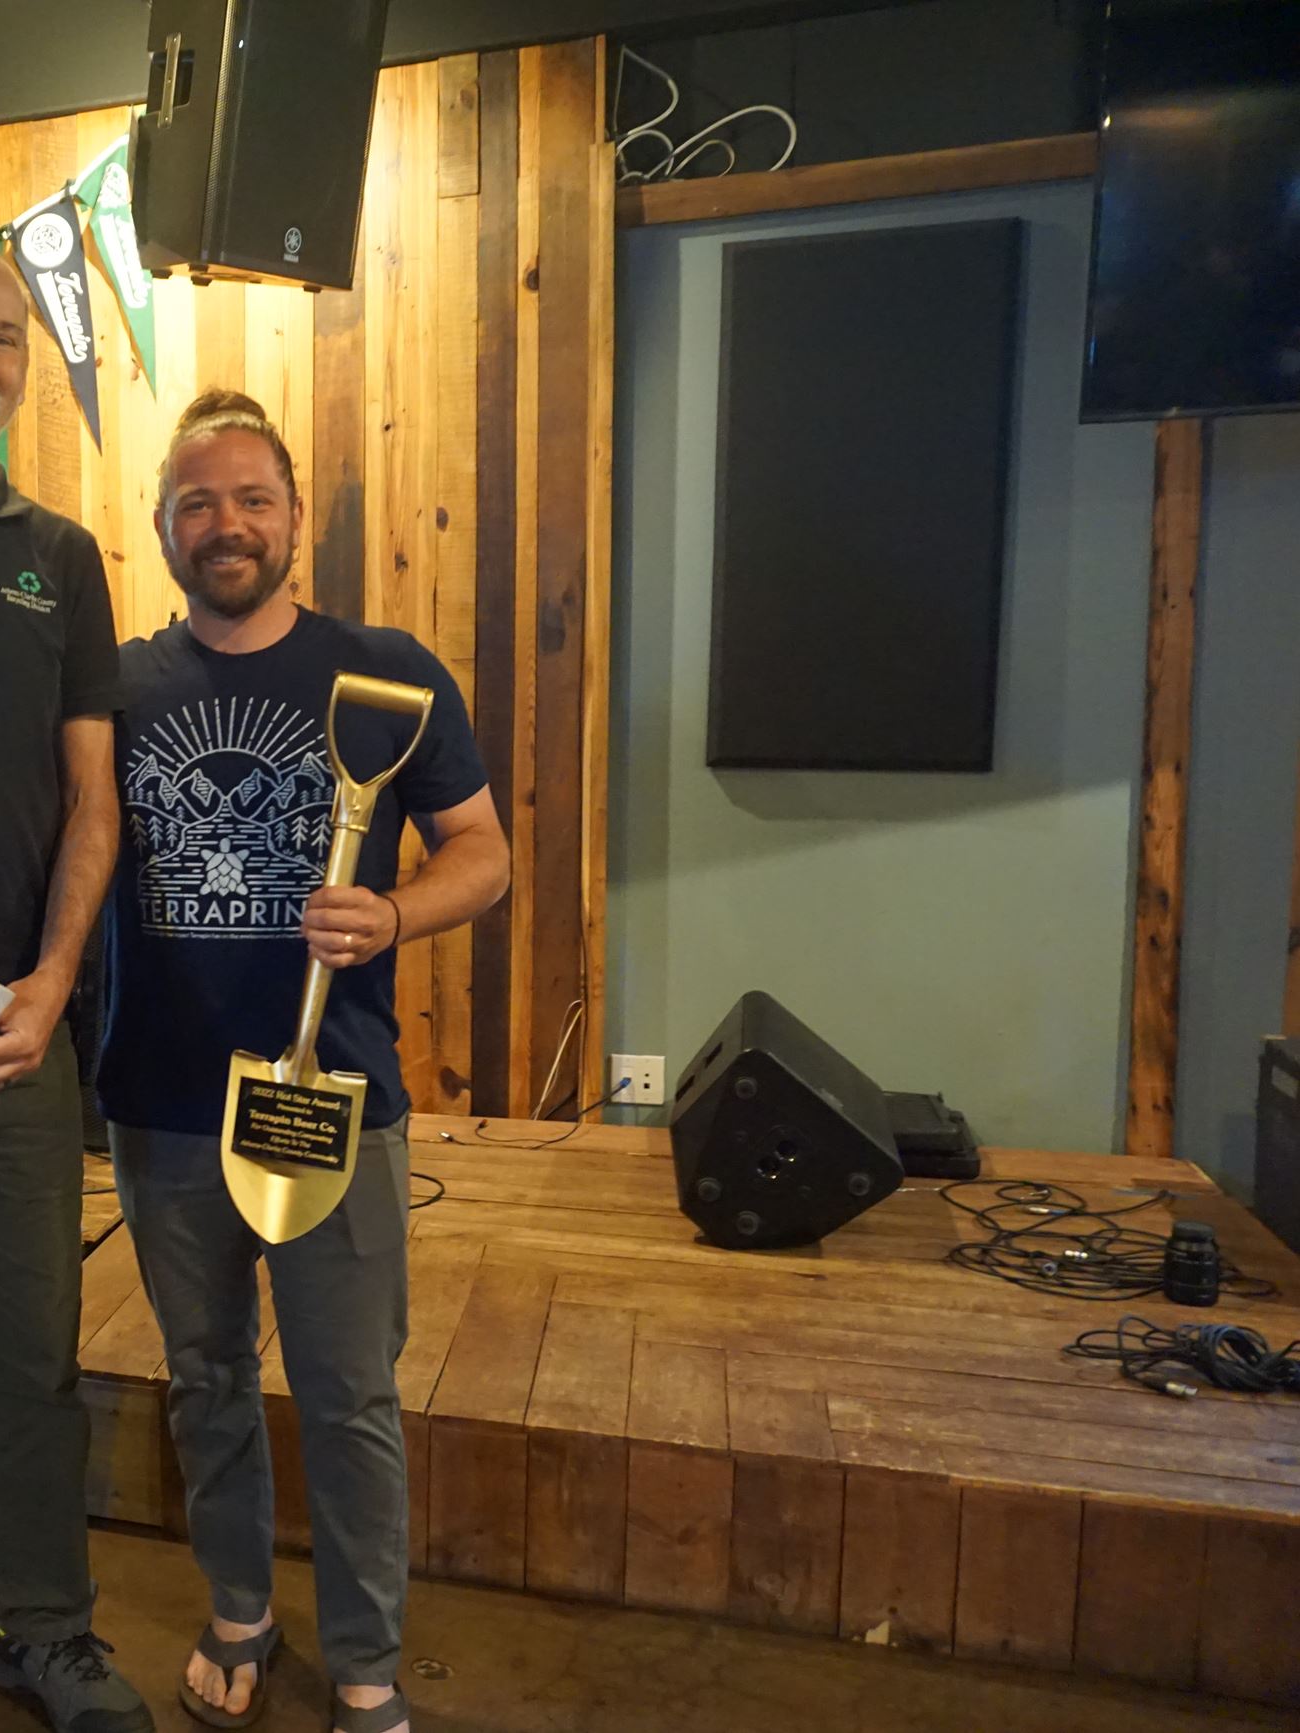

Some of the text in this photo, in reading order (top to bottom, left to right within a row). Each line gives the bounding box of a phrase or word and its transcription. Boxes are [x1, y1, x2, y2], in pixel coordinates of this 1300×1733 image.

[54, 272, 91, 362] Terrapin
[139, 899, 308, 925] TERRAPRIN
[252, 1086, 275, 1098] 2022
[311, 1097, 341, 1110] Award
[249, 1109, 338, 1134] Terrapin Beer Co.
